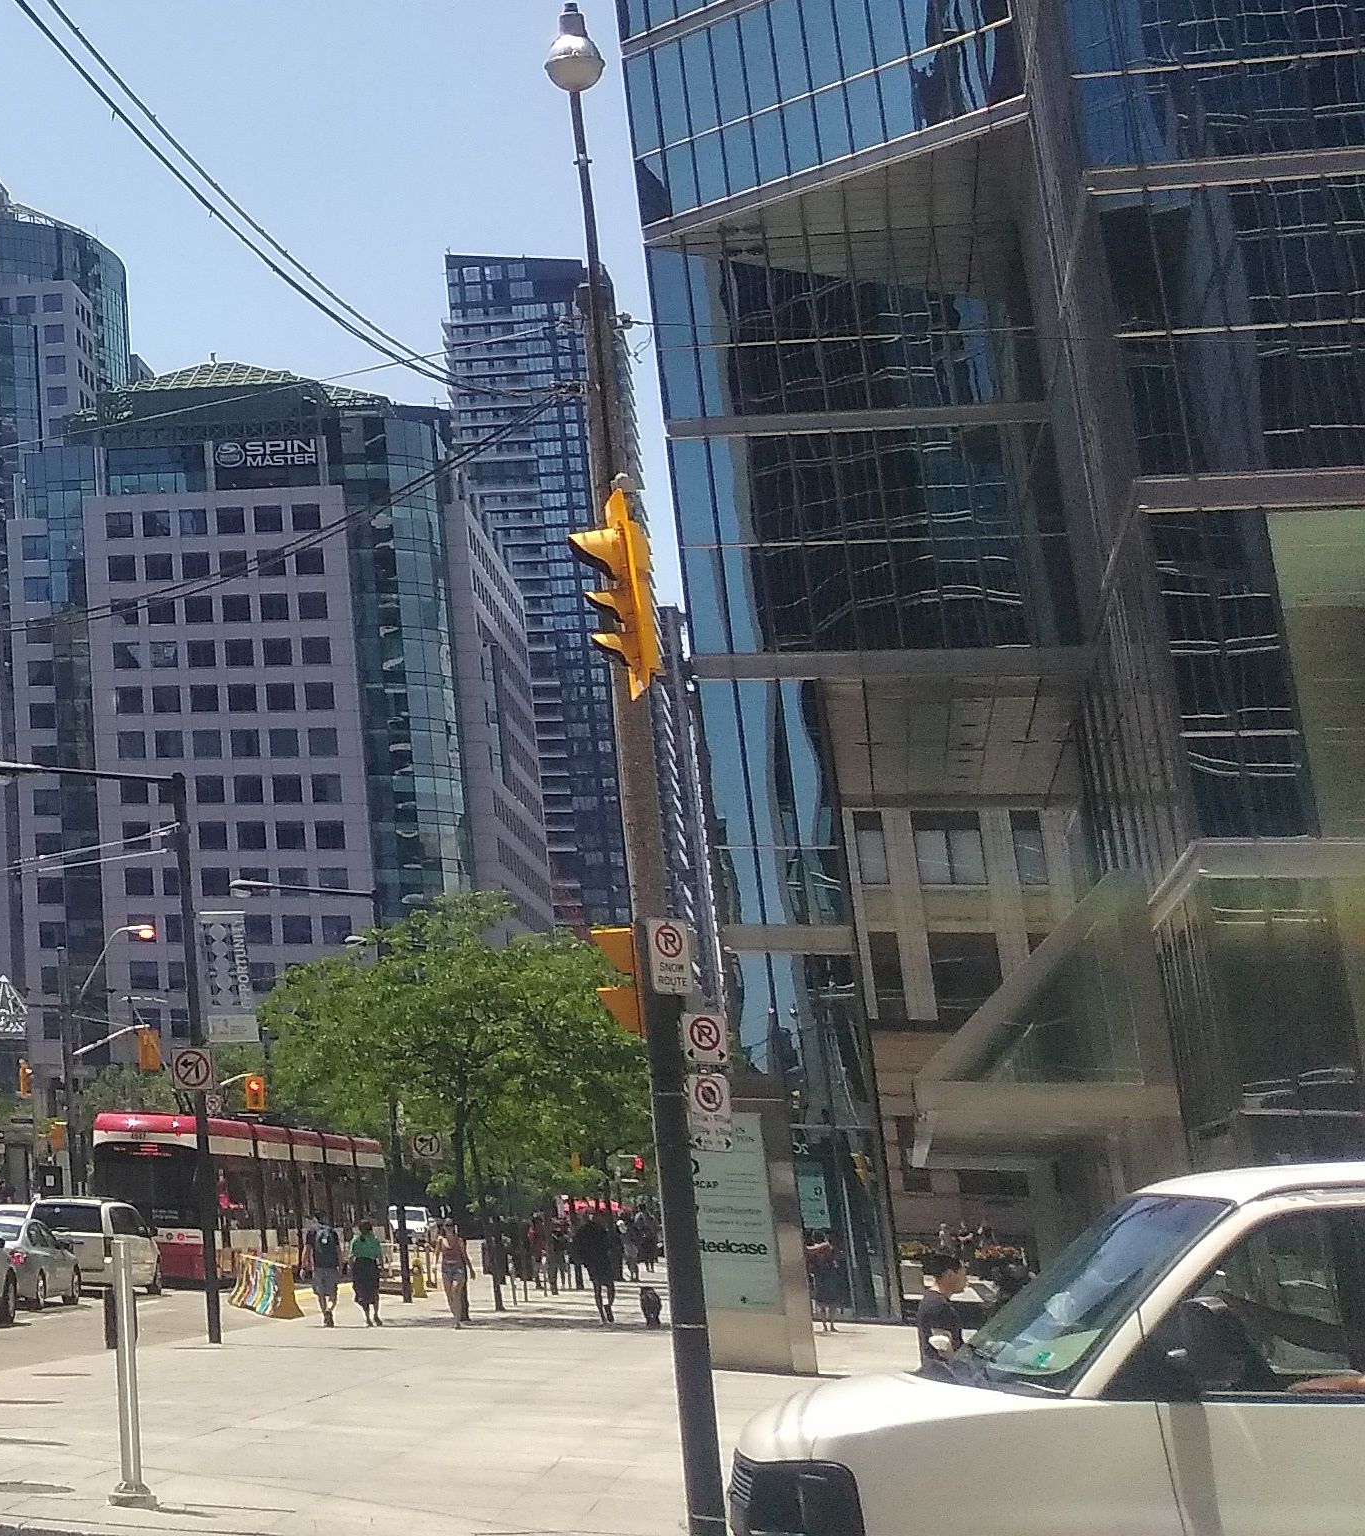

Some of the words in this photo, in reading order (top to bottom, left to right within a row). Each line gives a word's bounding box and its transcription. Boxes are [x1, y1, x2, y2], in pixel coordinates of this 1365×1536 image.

[245, 438, 316, 455] SPIN
[246, 453, 316, 467] MASTER
[659, 961, 684, 973] SNOW
[658, 975, 688, 987] ROUTE
[700, 1239, 768, 1255] teelcase
